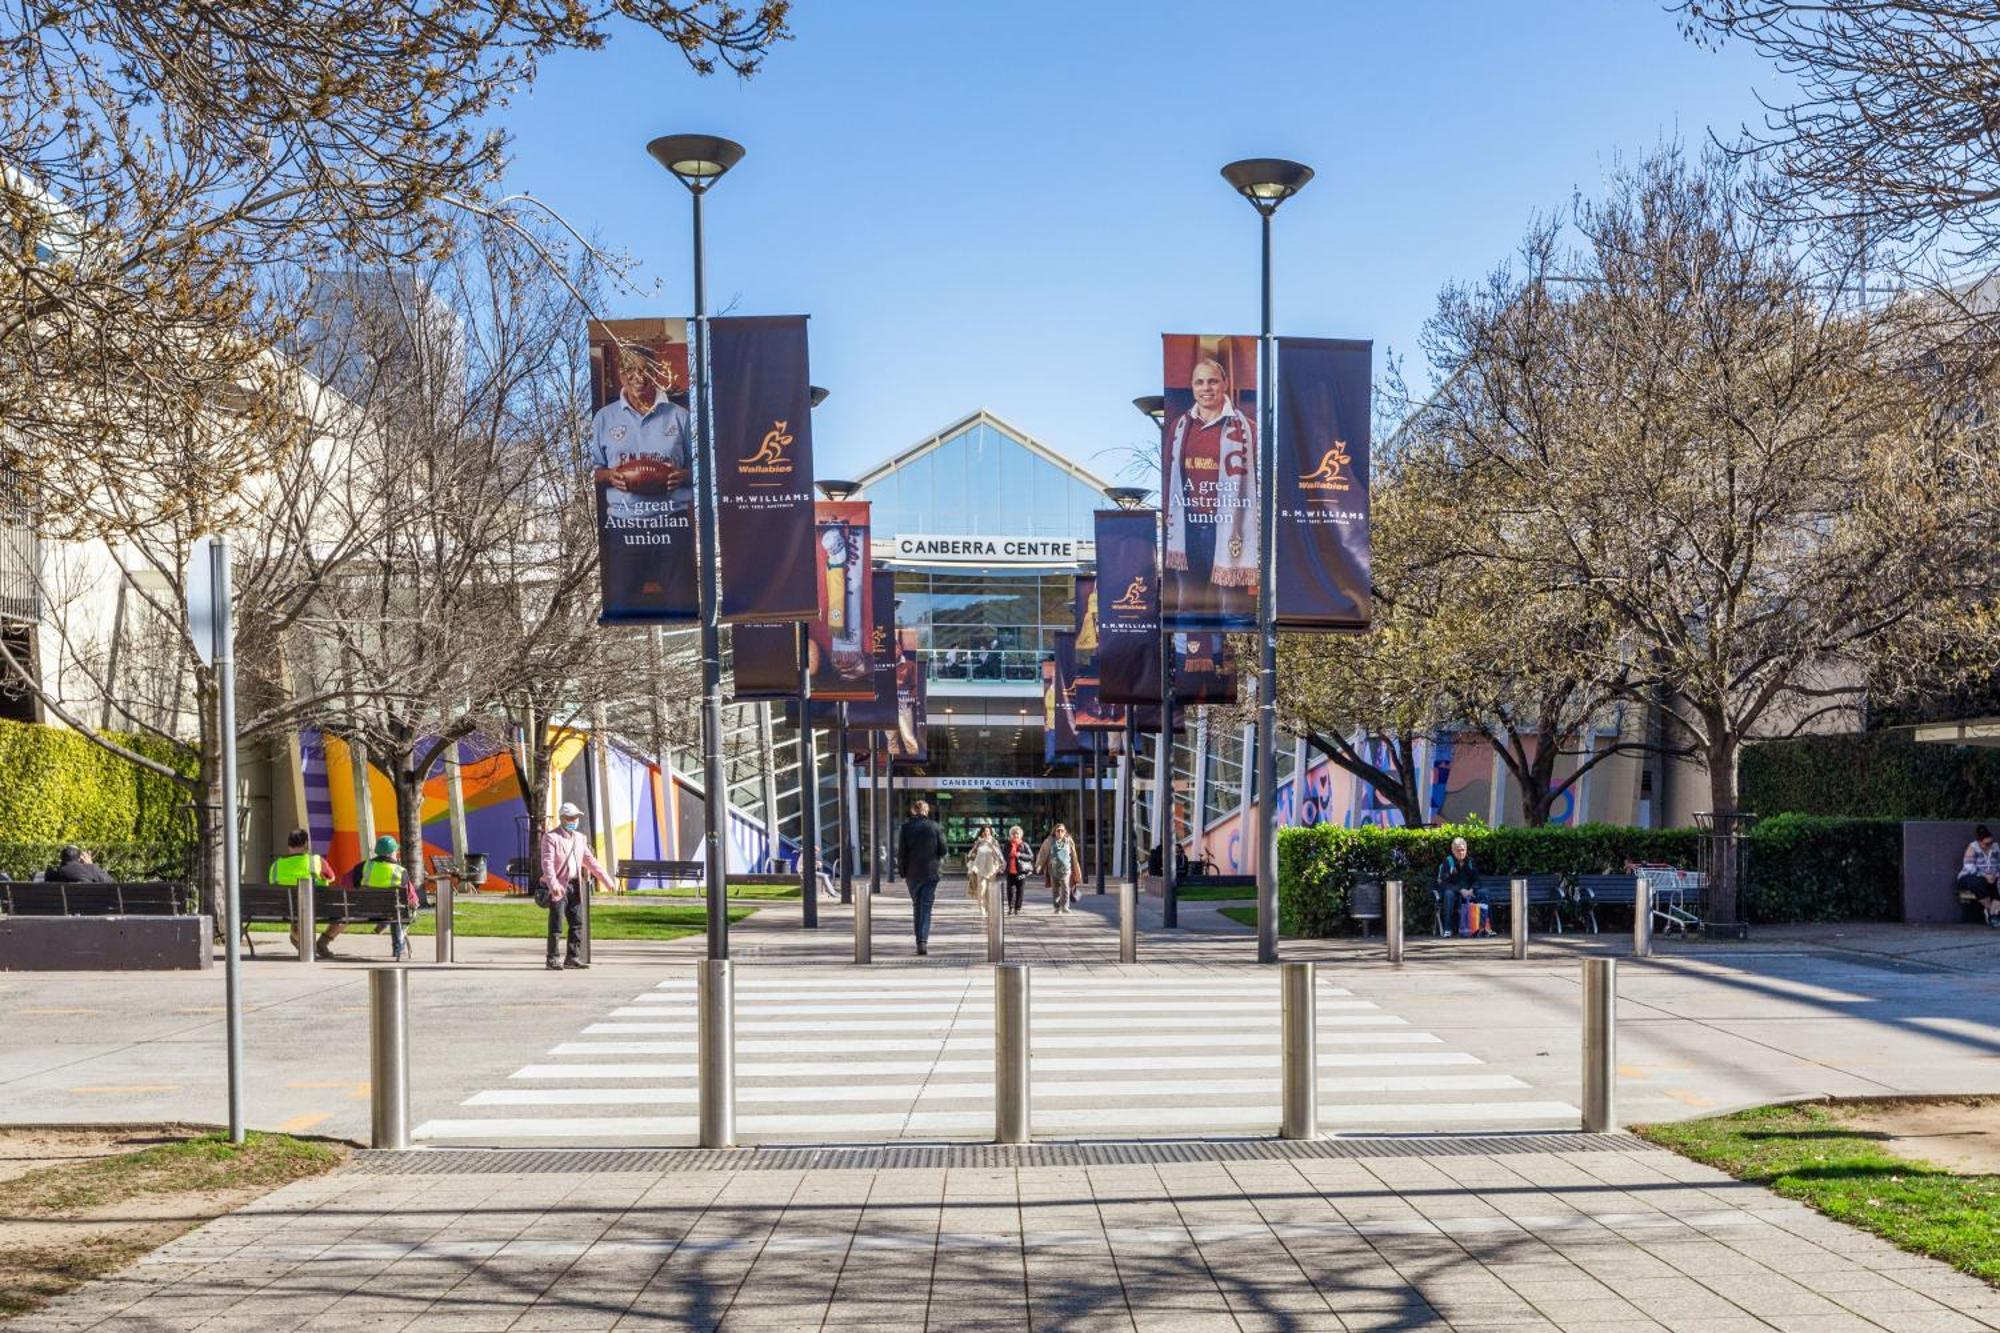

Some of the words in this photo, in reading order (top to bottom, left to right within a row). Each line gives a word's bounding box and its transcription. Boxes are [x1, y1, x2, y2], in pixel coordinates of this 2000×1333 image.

[738, 465, 793, 473] Wallabies
[1183, 477, 1195, 491] A
[1199, 480, 1239, 494] great
[618, 499, 629, 511] A
[634, 499, 675, 515] great
[1173, 493, 1252, 508] Australian
[604, 514, 689, 529] Australian
[1188, 510, 1233, 523] union
[624, 531, 671, 545] union
[901, 540, 997, 555] CANBERRA
[1003, 542, 1072, 556] CENTRE
[995, 779, 1032, 787] CENTRE
